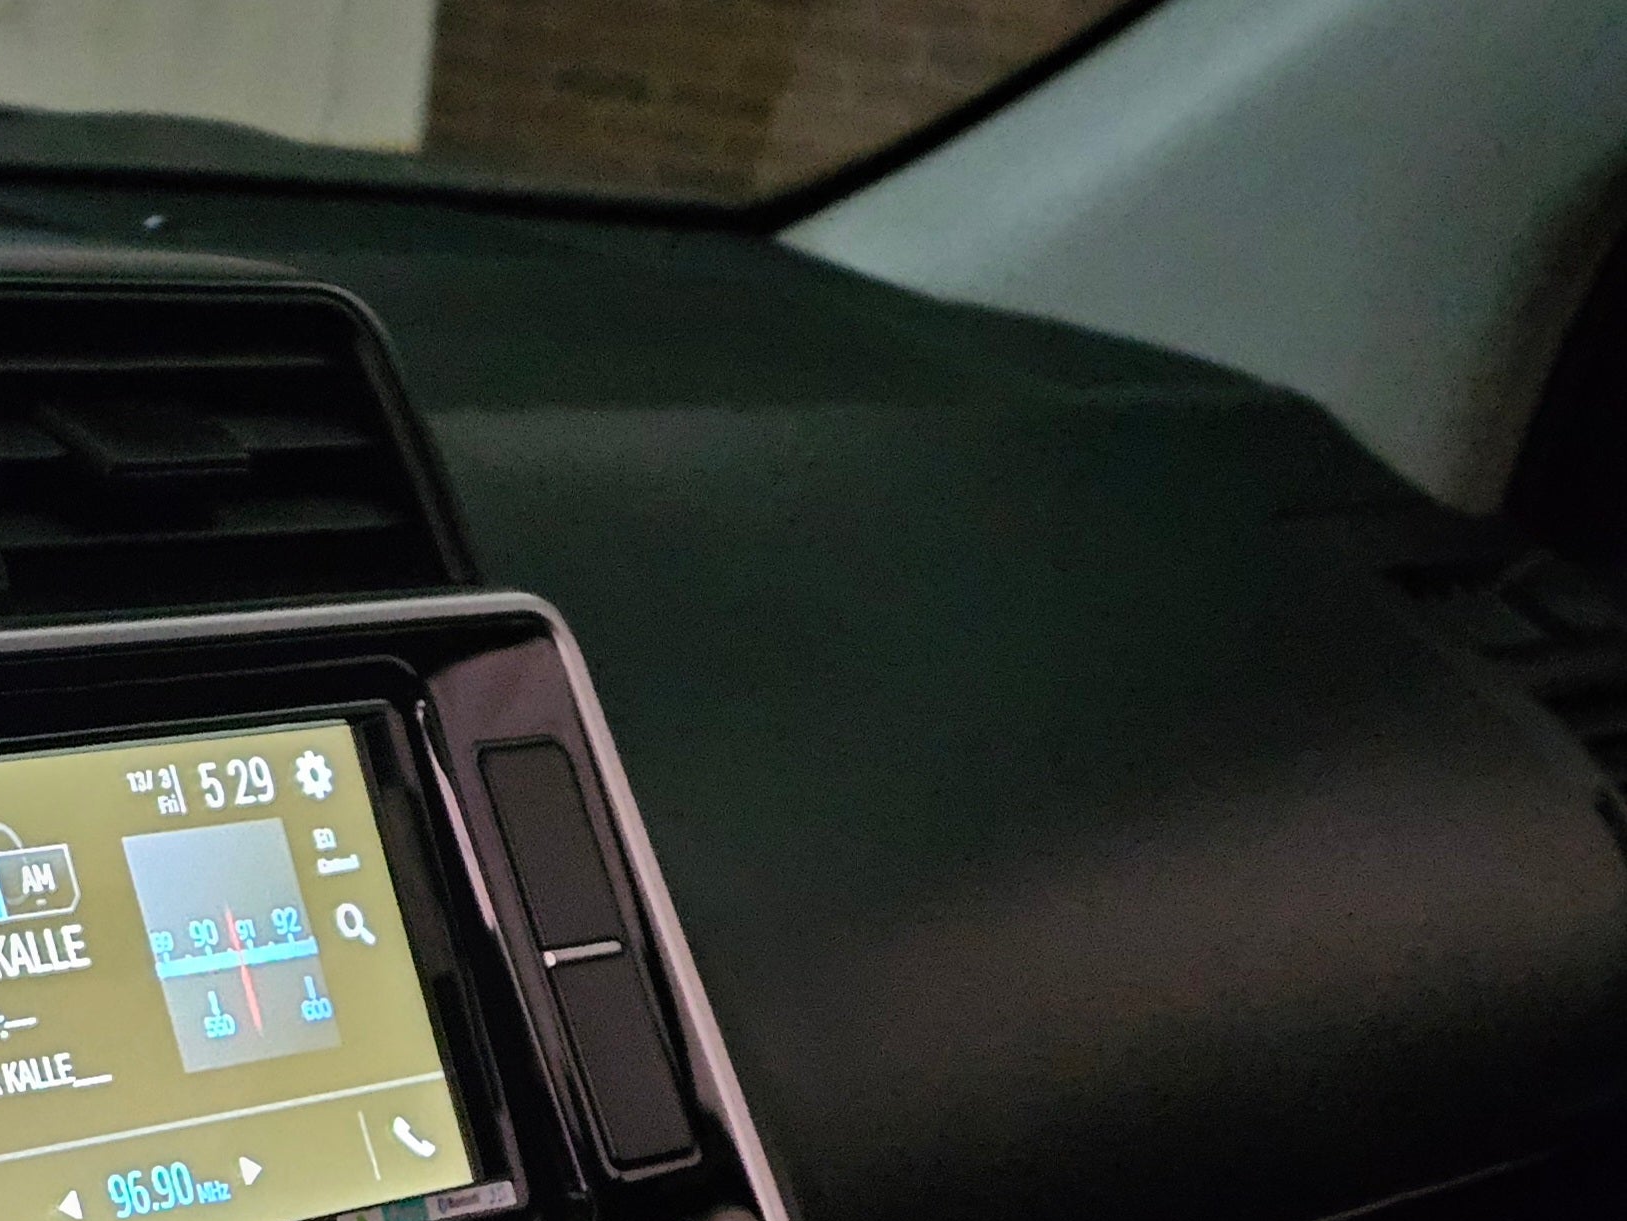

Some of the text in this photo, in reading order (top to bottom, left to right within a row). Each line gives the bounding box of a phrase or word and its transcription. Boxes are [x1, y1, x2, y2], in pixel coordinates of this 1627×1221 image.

[158, 794, 179, 815] Fri
[21, 863, 56, 895] AM
[189, 919, 219, 947] 90
[235, 919, 256, 941] 91
[272, 907, 302, 935] 92
[107, 1161, 232, 1219] 96.90 MHz
